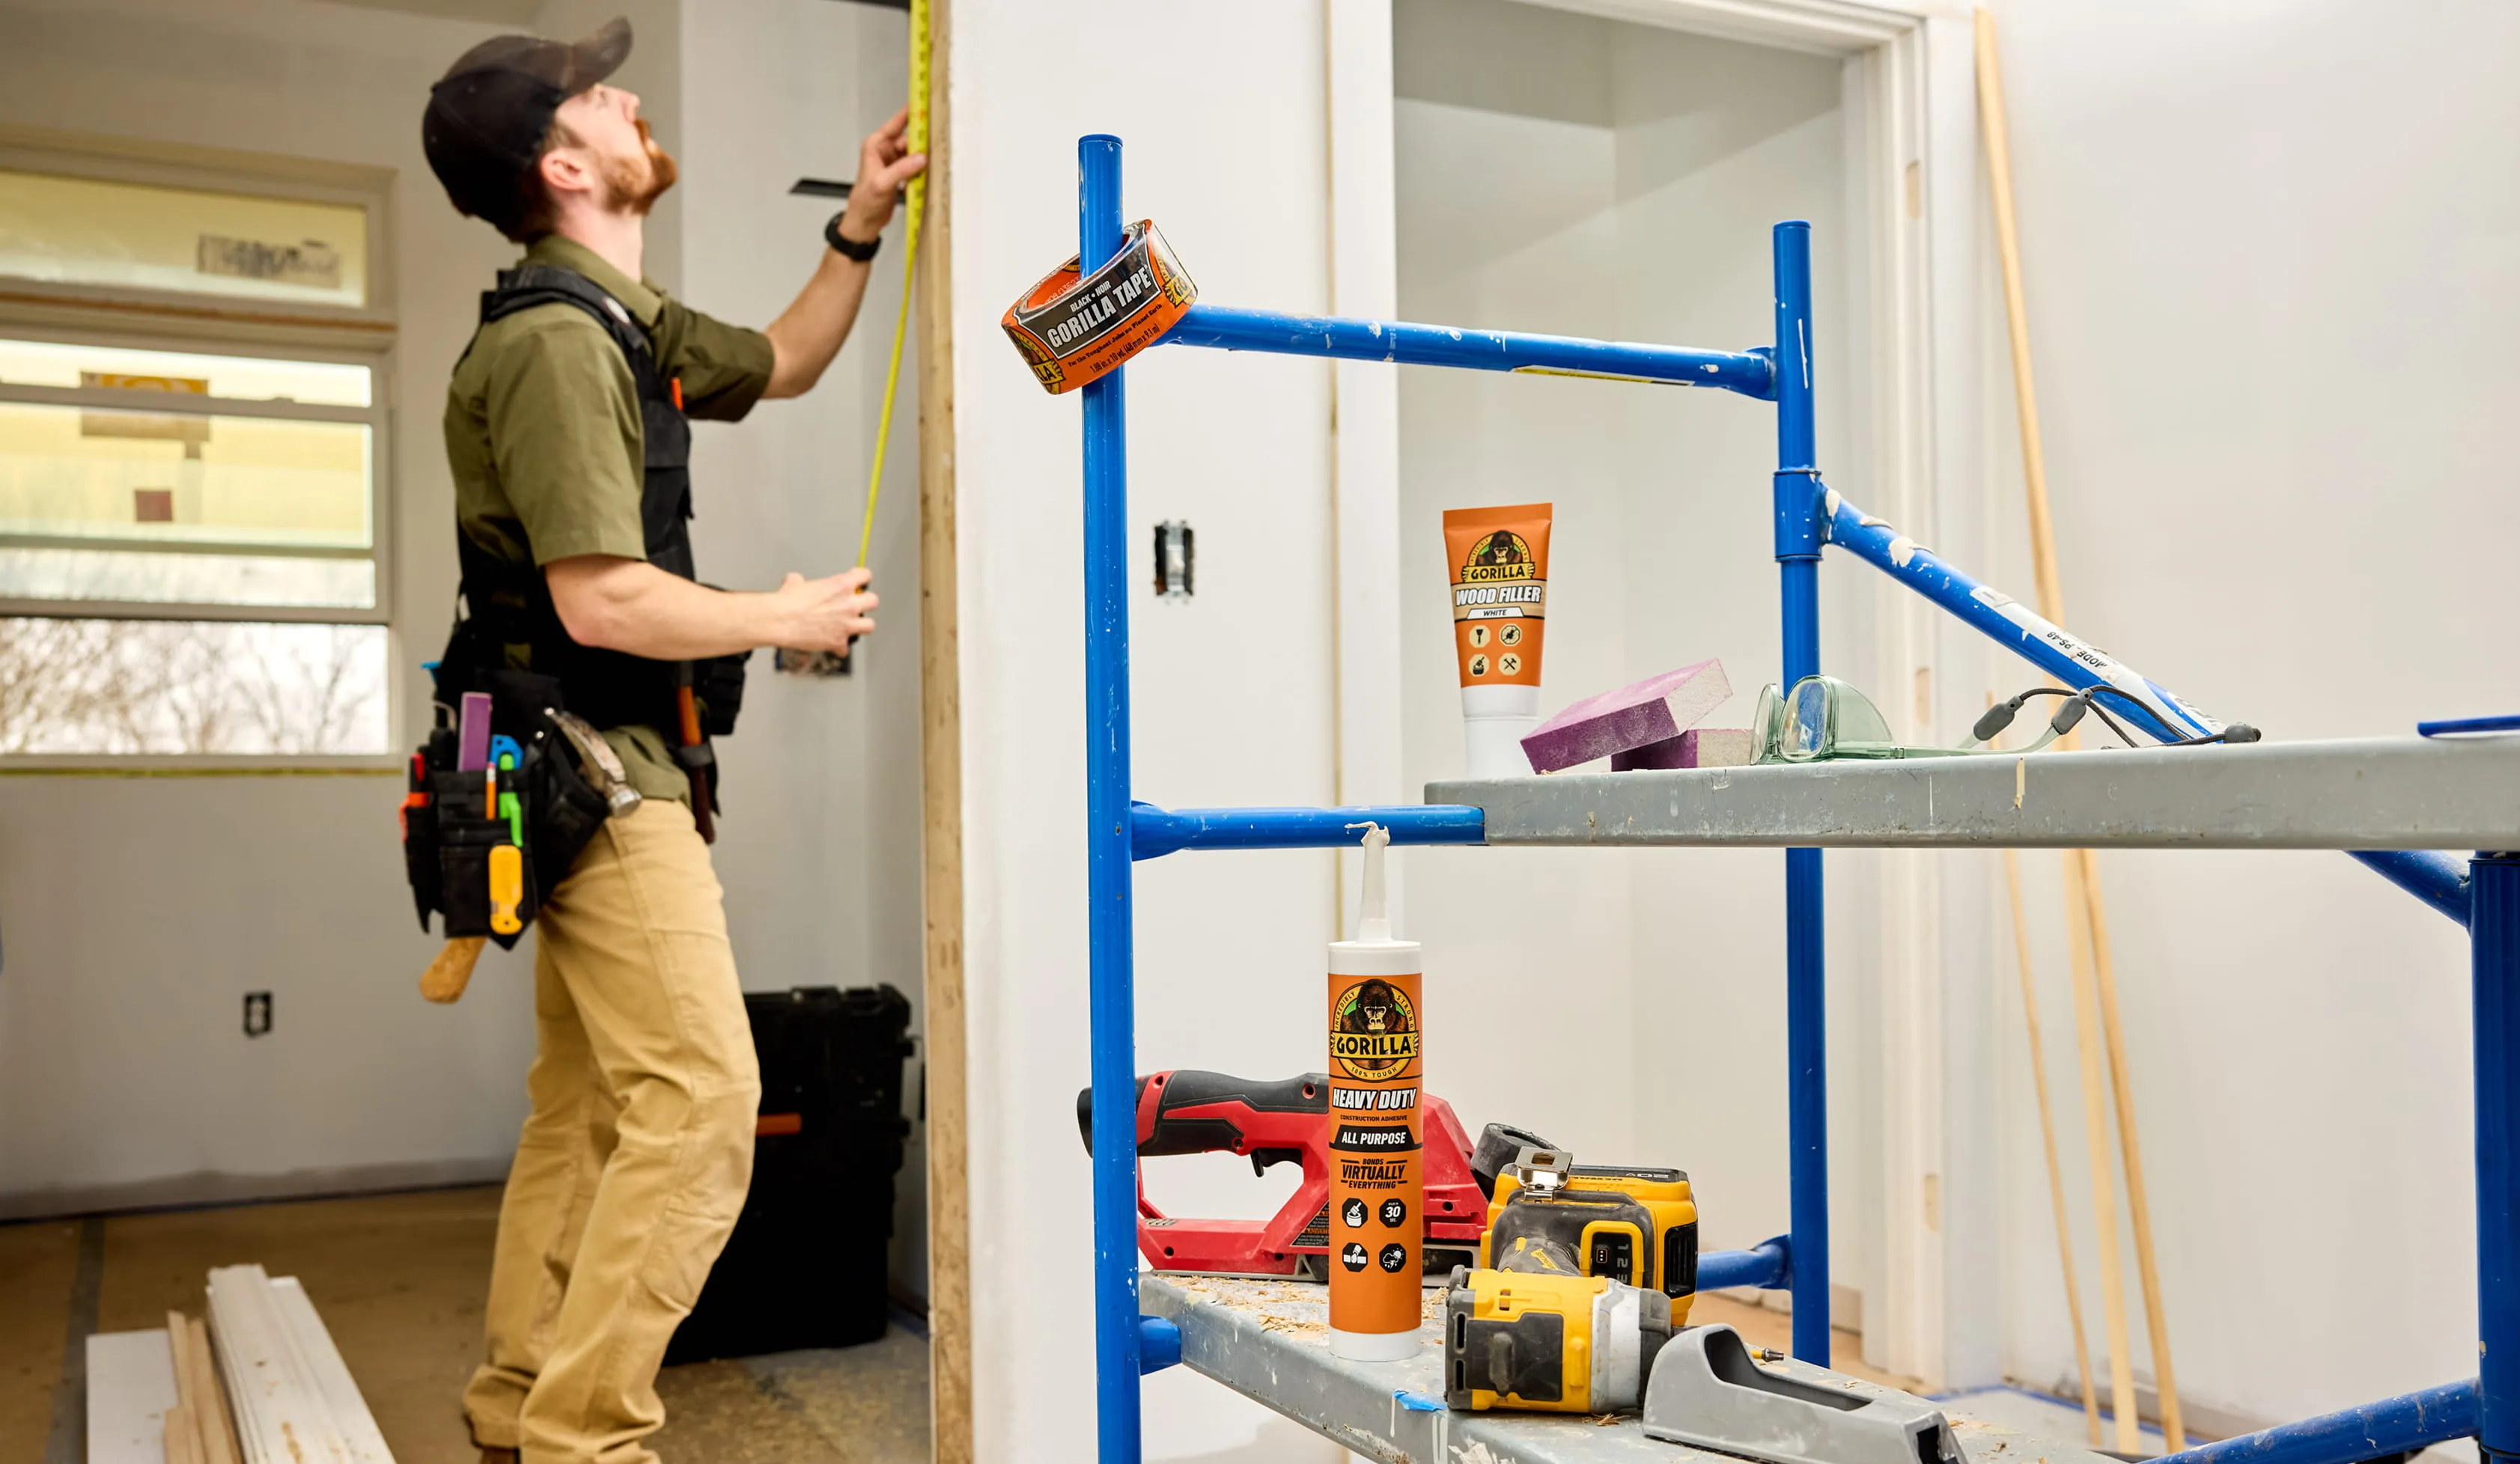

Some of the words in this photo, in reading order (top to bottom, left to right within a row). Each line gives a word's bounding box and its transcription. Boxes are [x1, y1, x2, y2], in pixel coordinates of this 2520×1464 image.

[1070, 293, 1092, 313] BLACK
[1095, 281, 1112, 297] NOIR
[1047, 296, 1117, 348] GORILLA
[1112, 266, 1151, 308] TAPE
[1086, 341, 1112, 358] Toughest
[1112, 332, 1125, 343] Jobs
[1131, 314, 1150, 329] Planet
[1148, 303, 1163, 316] Earth
[1141, 333, 1148, 342] x
[1143, 328, 1154, 339] 9.1
[1124, 342, 1134, 354] (48
[1132, 337, 1144, 349] mm
[1109, 353, 1119, 362] 10
[1470, 565, 1525, 580] GORILLA
[1455, 588, 1497, 607] WOOD
[1497, 585, 1542, 603] FILLER
[1334, 991, 1356, 1029] INCREDIBLY
[1396, 995, 1414, 1028] STRONG
[1336, 1036, 1412, 1055] GORILLA
[1351, 1067, 1369, 1078] 100%
[1372, 1067, 1398, 1078] TOUGH
[1332, 1088, 1376, 1109] HEAVY
[1377, 1088, 1417, 1110] DUTY
[1341, 1132, 1358, 1144] ALL
[1360, 1131, 1406, 1144] PURPOSE
[1341, 1164, 1405, 1181] VIRTUALLY
[1348, 1180, 1396, 1189] EVERYTHING
[1385, 1206, 1401, 1218] 30
[1616, 1257, 1629, 1268] 2
